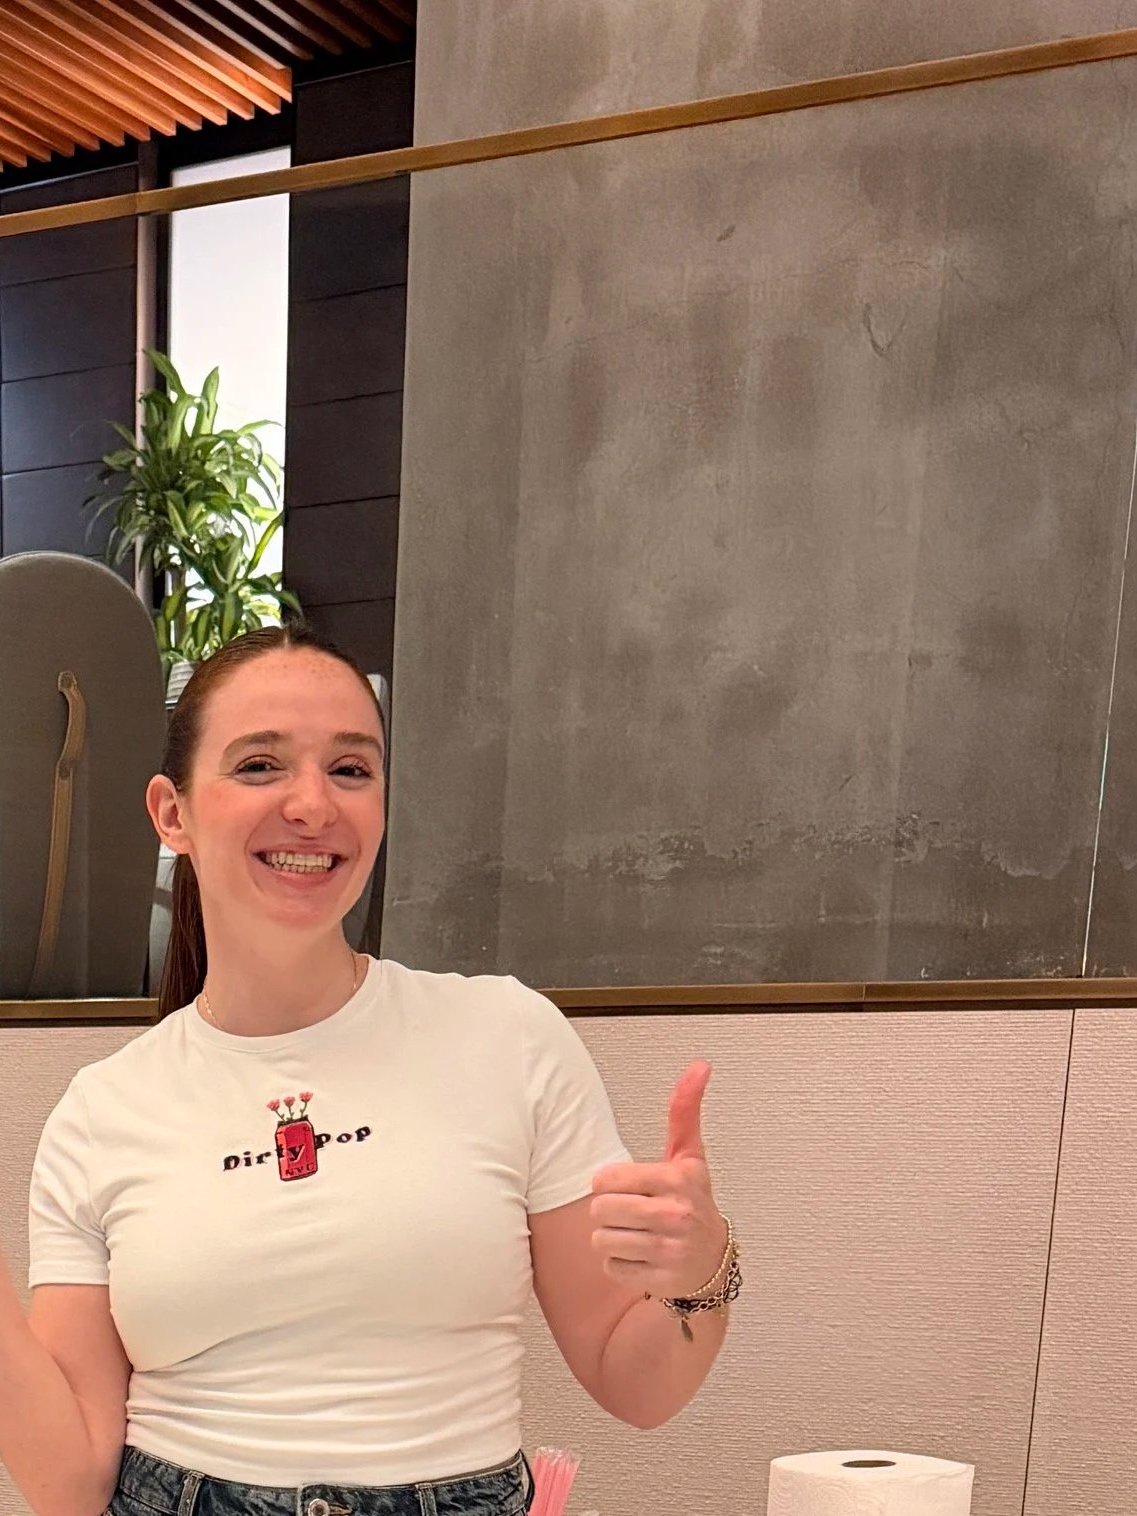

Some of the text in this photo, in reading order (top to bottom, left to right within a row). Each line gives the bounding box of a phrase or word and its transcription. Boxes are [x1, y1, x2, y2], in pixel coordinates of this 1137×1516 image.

[223, 1125, 372, 1172] Dirty Pop
[285, 1162, 316, 1177] NYC
